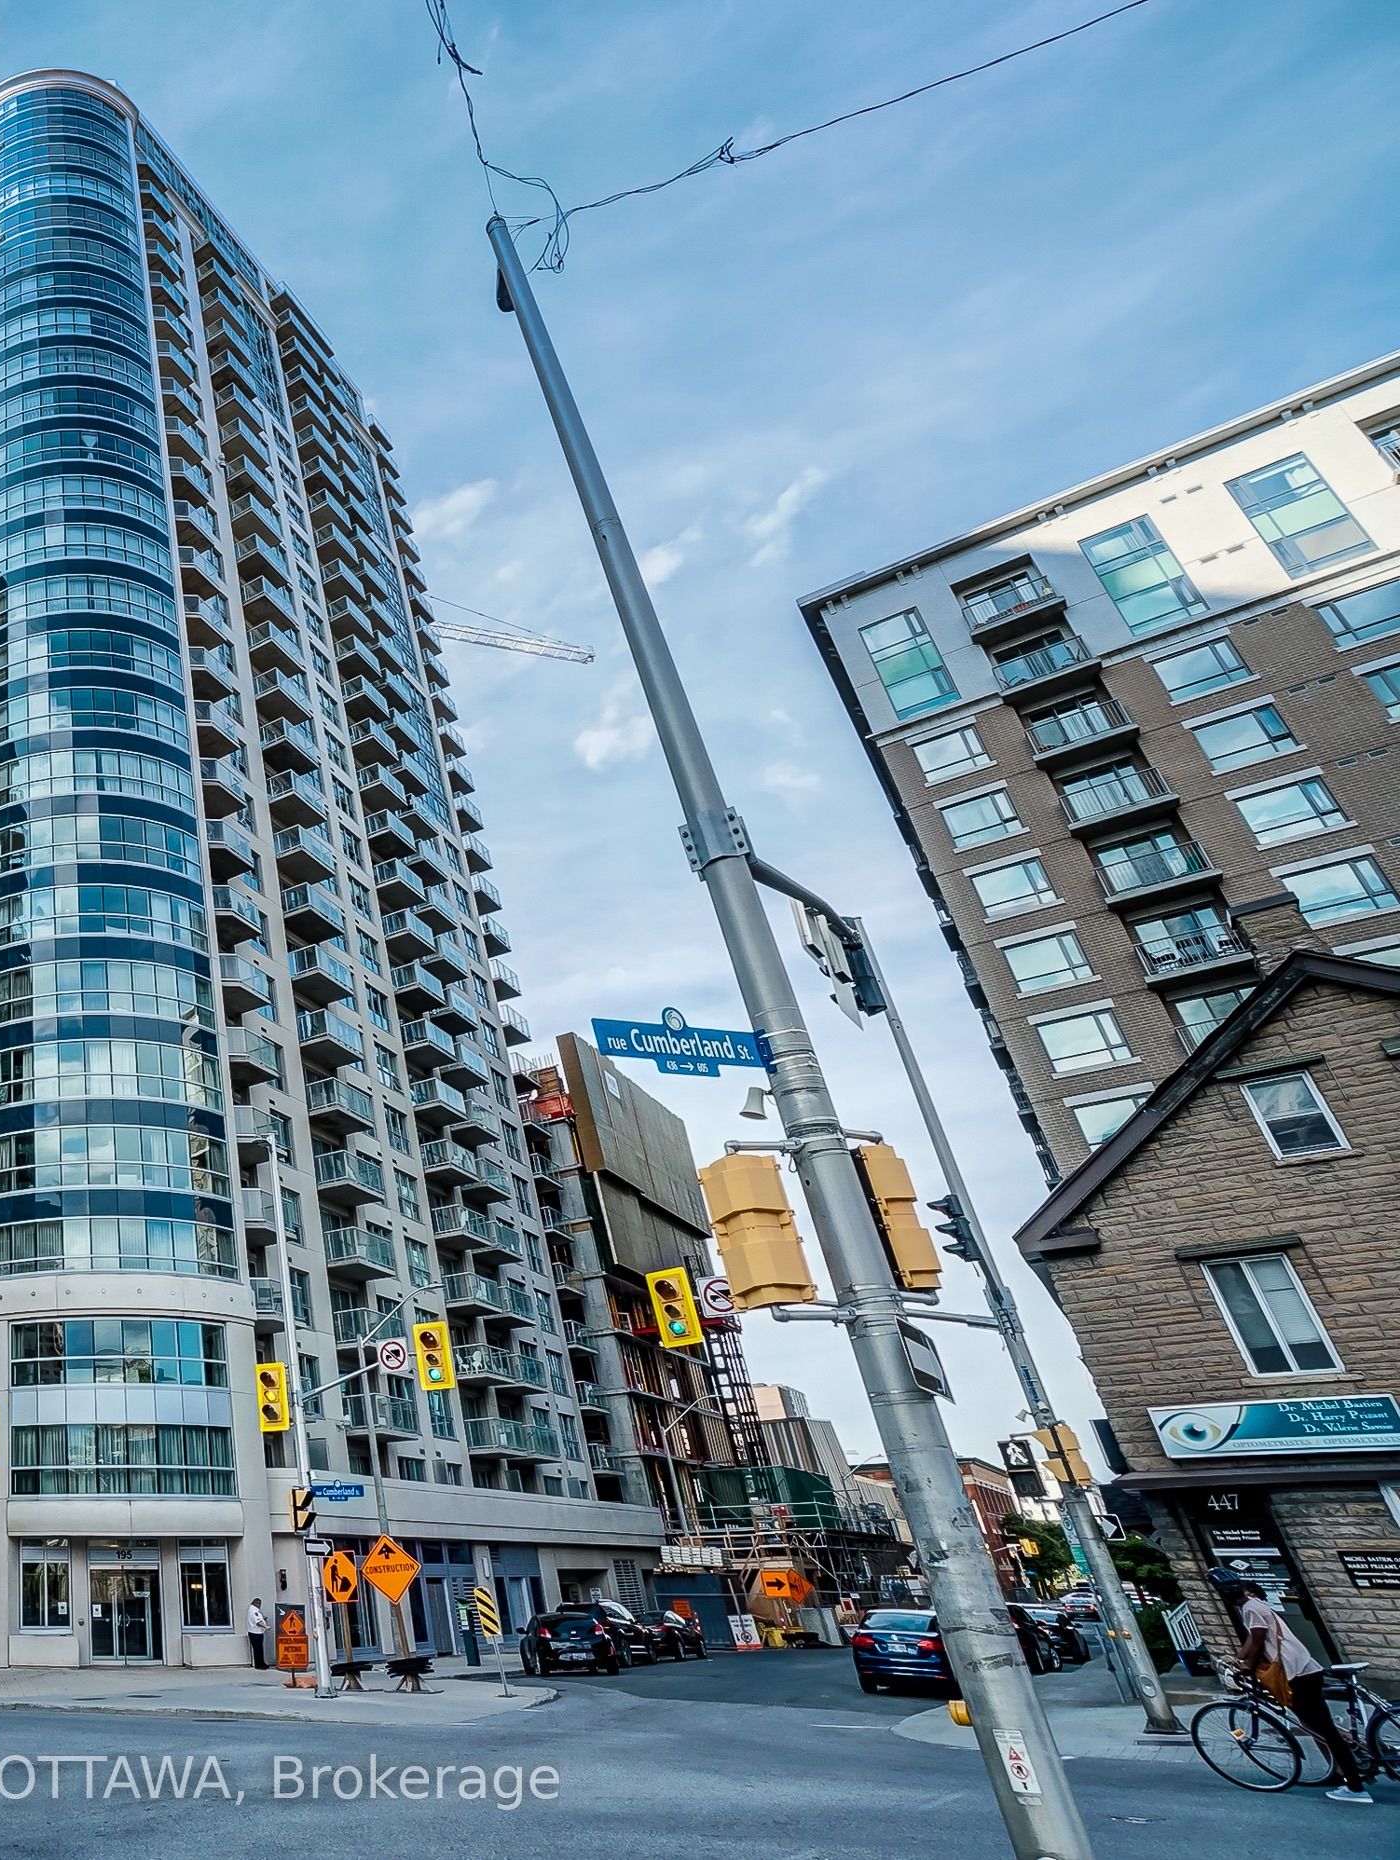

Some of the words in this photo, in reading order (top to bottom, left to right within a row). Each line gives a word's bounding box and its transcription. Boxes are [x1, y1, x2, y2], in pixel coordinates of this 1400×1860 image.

[607, 1036, 628, 1051] rue
[630, 1028, 736, 1060] Cumberland
[737, 1044, 755, 1061] St.
[1301, 1400, 1341, 1411] Michel
[1342, 1399, 1384, 1409] Bastien
[1311, 1411, 1346, 1423] Harry
[322, 1487, 355, 1496] Cumberland
[1207, 1493, 1239, 1511] 447
[115, 1550, 133, 1560] 195
[365, 1562, 416, 1575] CONSTRUCTION
